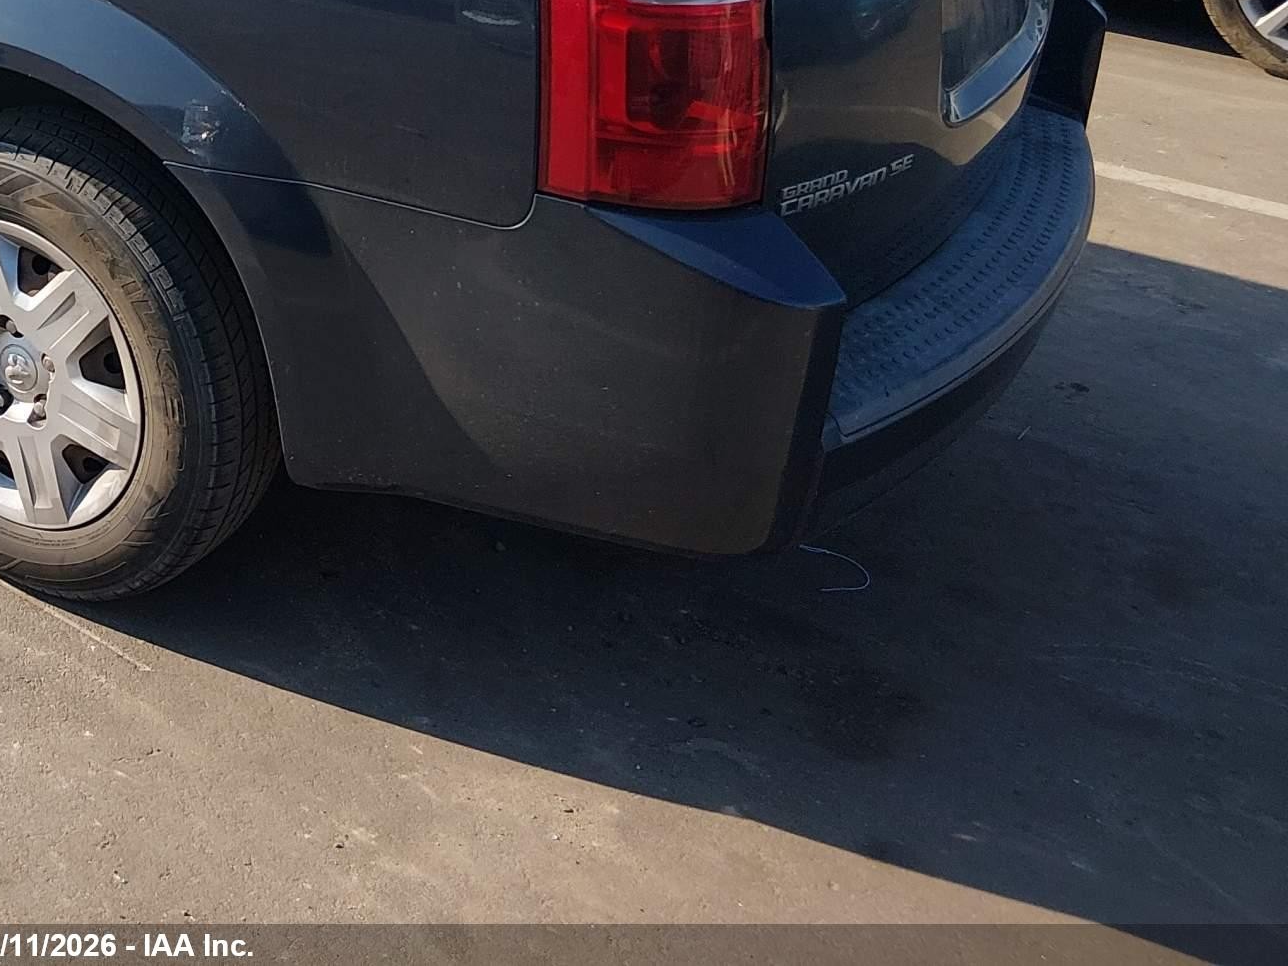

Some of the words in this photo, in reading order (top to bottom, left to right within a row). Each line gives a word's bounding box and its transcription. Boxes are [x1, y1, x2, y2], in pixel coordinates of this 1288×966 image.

[780, 167, 887, 216] CARAVAN
[890, 154, 914, 176] SE
[782, 169, 848, 200] GRAND
